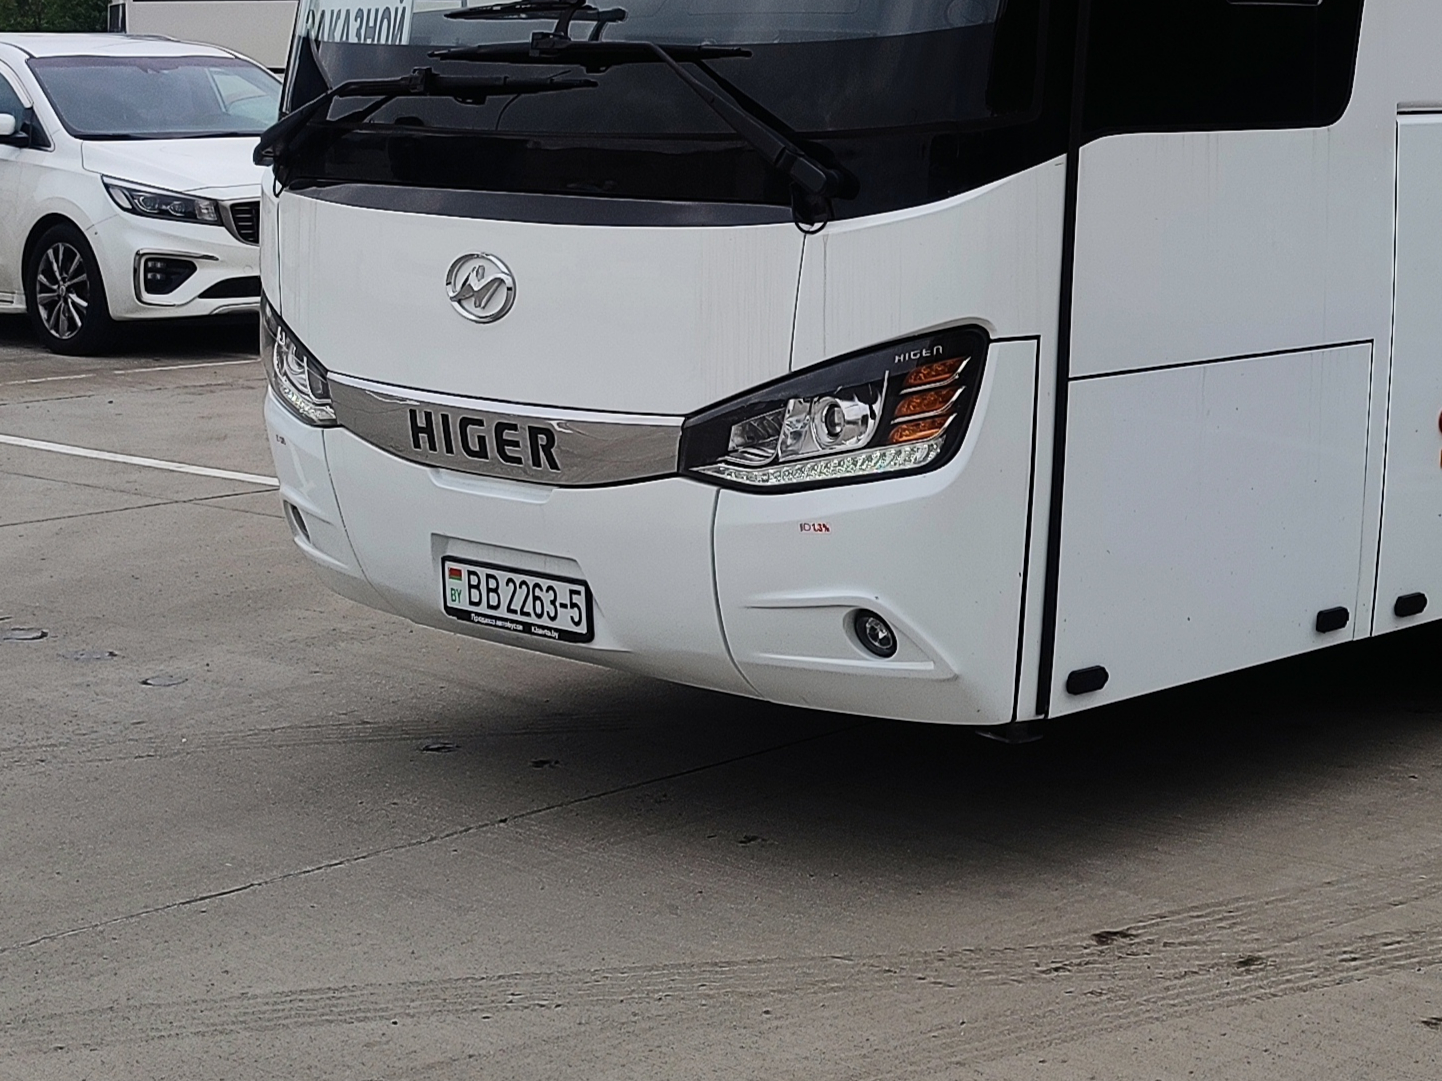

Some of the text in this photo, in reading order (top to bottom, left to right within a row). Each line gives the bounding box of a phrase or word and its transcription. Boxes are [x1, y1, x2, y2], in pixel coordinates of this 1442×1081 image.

[408, 408, 561, 472] HIGER
[450, 587, 462, 604] BY
[505, 577, 583, 627] 2263-5
